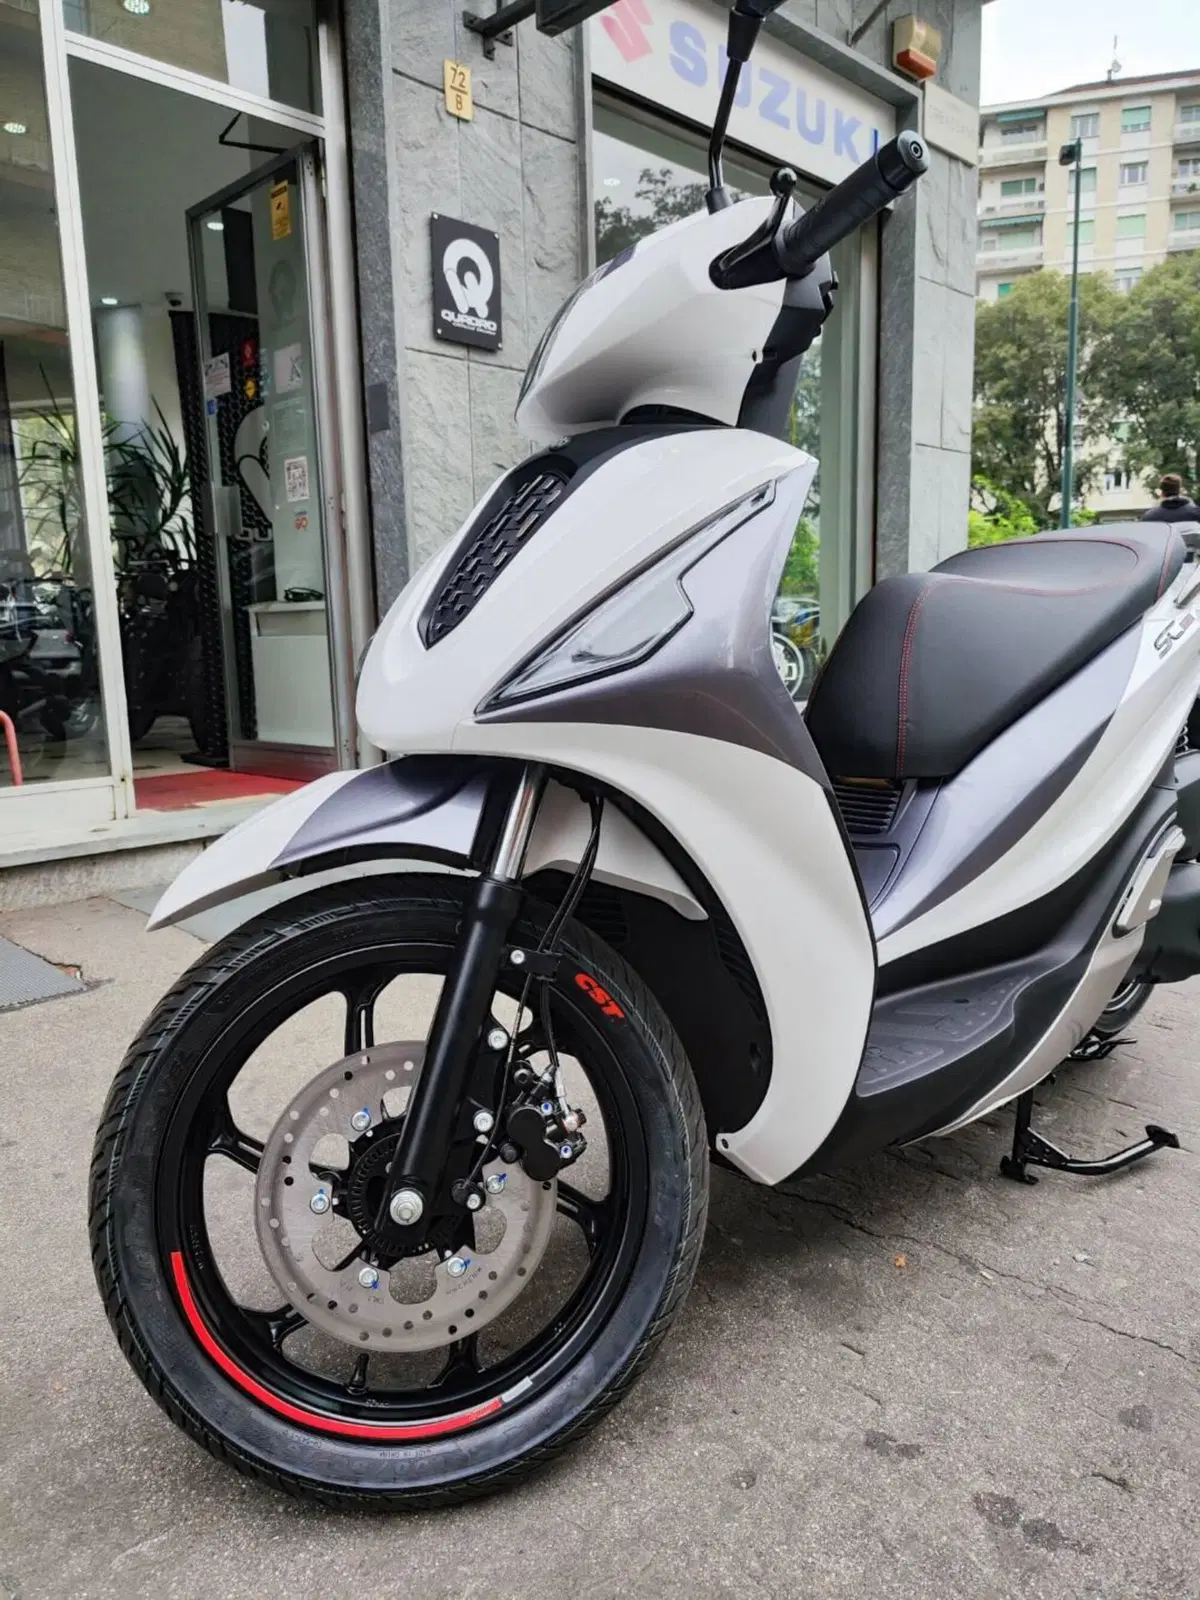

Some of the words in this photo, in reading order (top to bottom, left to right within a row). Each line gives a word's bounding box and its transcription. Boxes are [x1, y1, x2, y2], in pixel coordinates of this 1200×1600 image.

[451, 66, 466, 88] 72
[668, 19, 880, 166] SUZUKI
[441, 309, 497, 331] QUADRO
[574, 973, 625, 1018] CST
